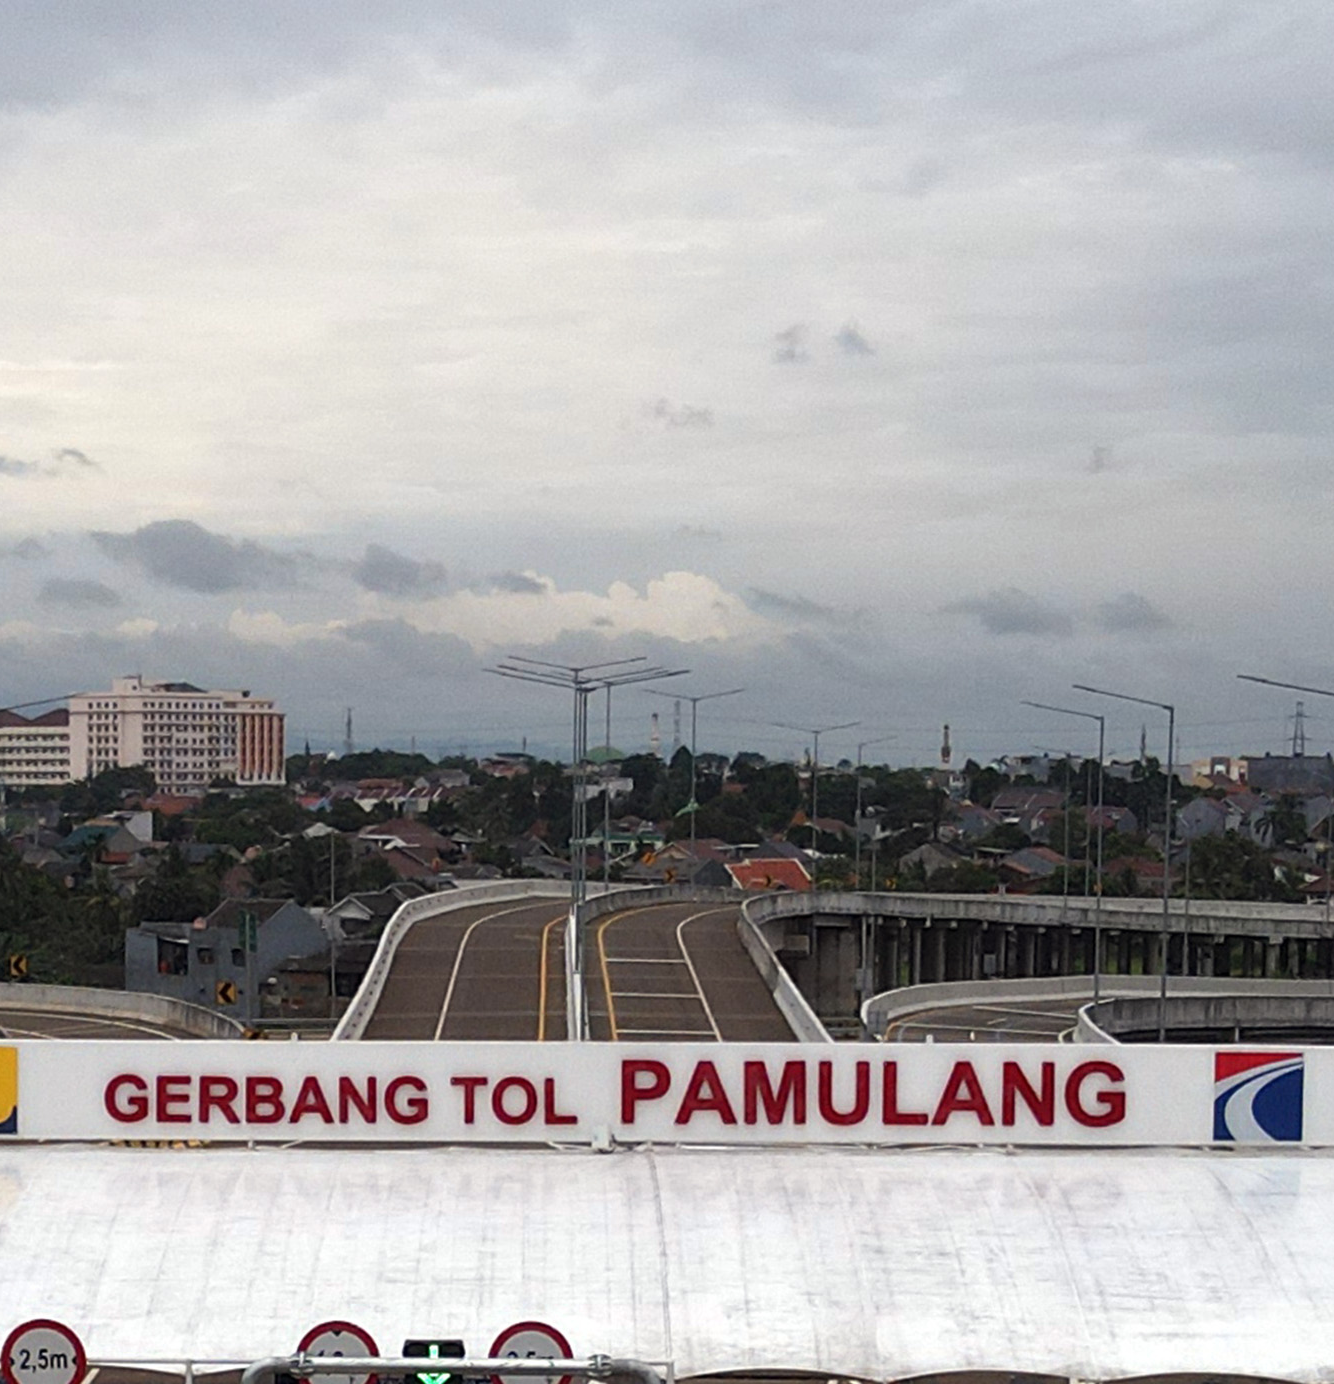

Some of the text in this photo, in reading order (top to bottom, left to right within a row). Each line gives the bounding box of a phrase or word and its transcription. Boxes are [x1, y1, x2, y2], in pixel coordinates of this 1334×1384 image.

[104, 1059, 1127, 1128] GERBANG TOL PAMULANG
[19, 1348, 67, 1373] 2,5m
